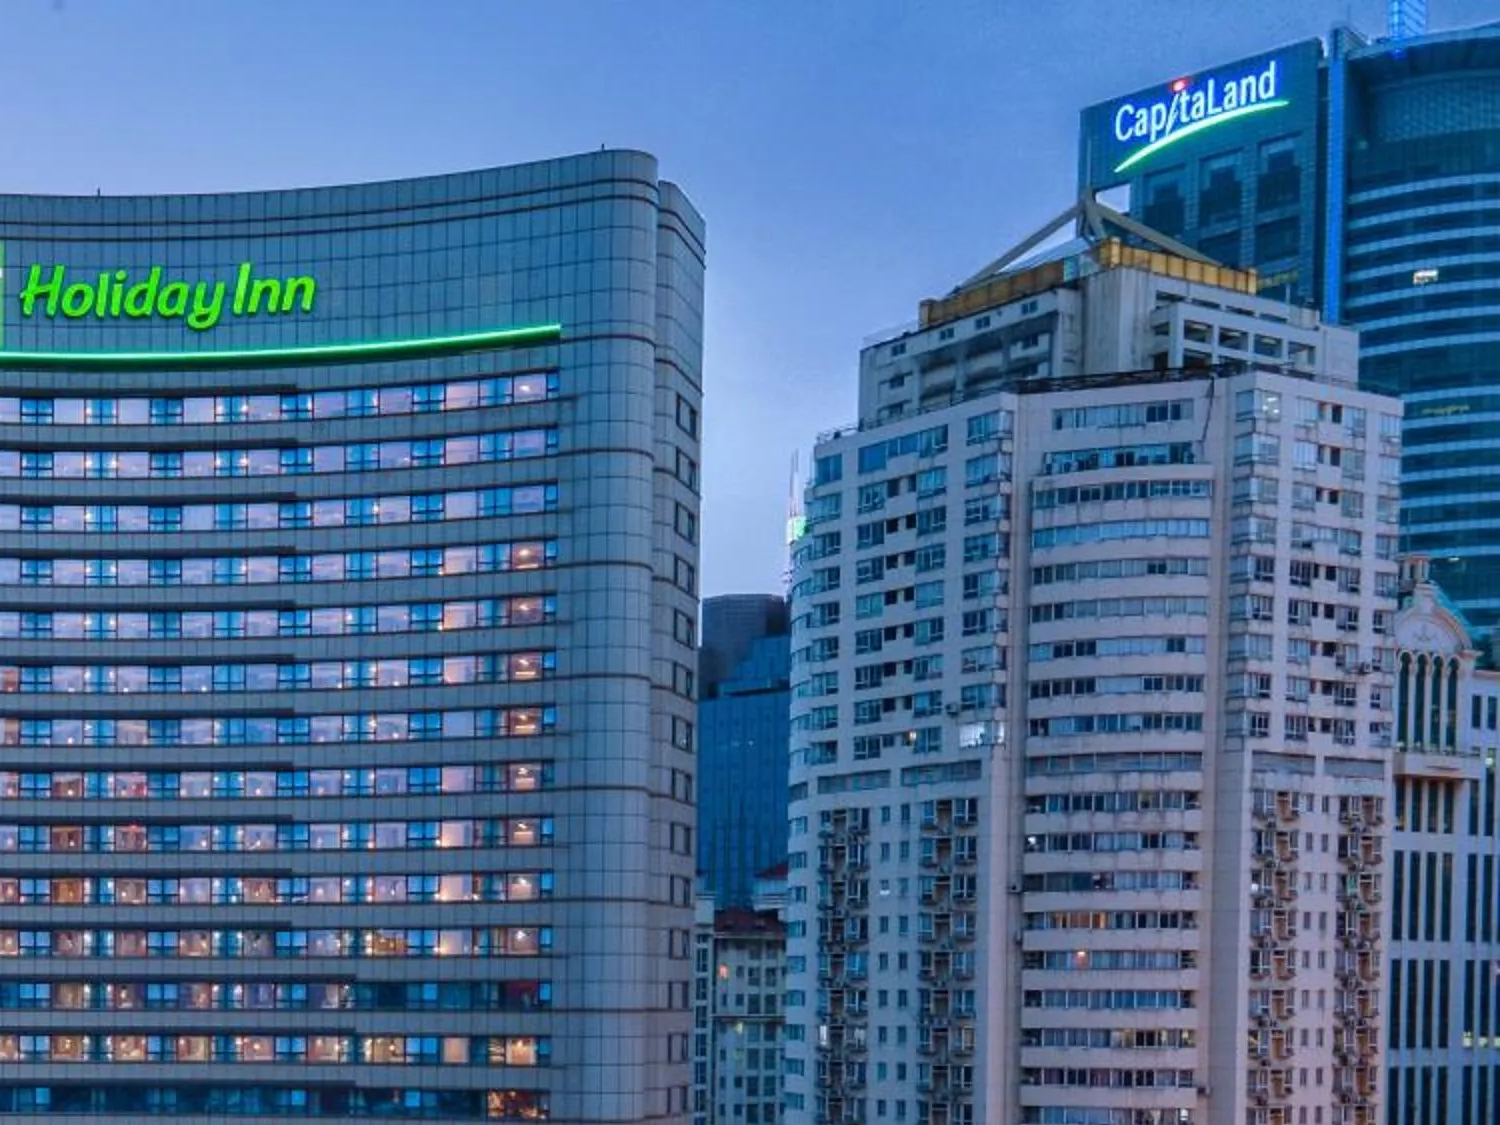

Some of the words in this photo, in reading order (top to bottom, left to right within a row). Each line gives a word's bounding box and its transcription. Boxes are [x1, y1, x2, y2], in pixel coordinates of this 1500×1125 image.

[1115, 61, 1276, 142] CapitaLand
[20, 263, 225, 330] Holiday
[231, 262, 317, 315] Inn
